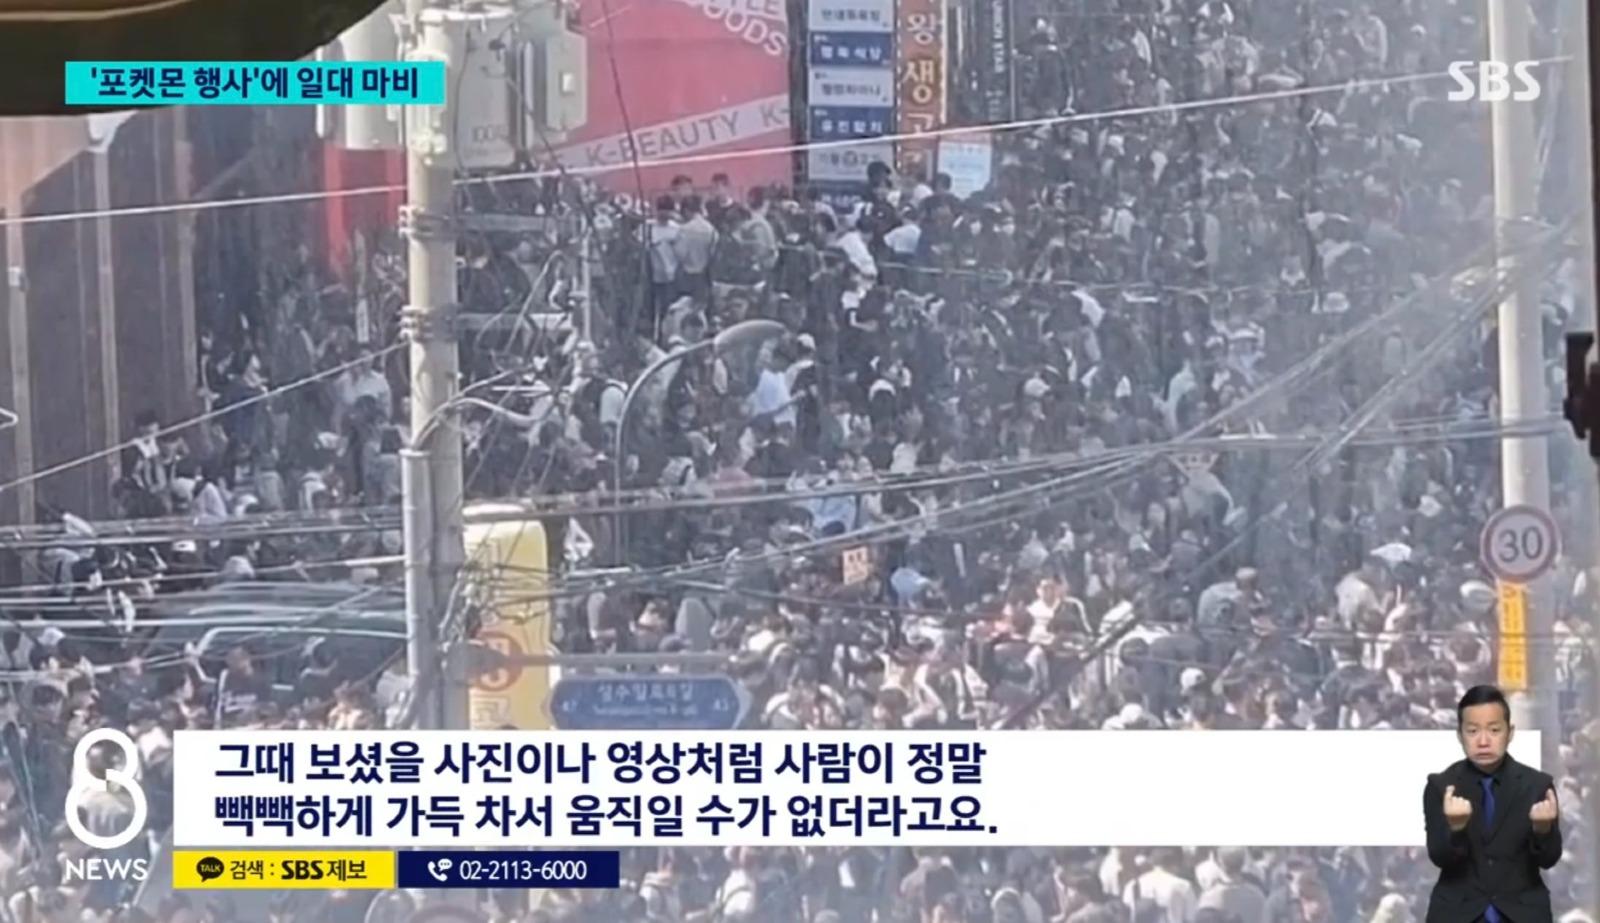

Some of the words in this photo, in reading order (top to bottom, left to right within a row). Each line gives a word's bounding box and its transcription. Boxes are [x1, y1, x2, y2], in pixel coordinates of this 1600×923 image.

[684, 0, 787, 56] OODS
[585, 111, 740, 167] K-BEAUTY
[1501, 526, 1543, 563] 30
